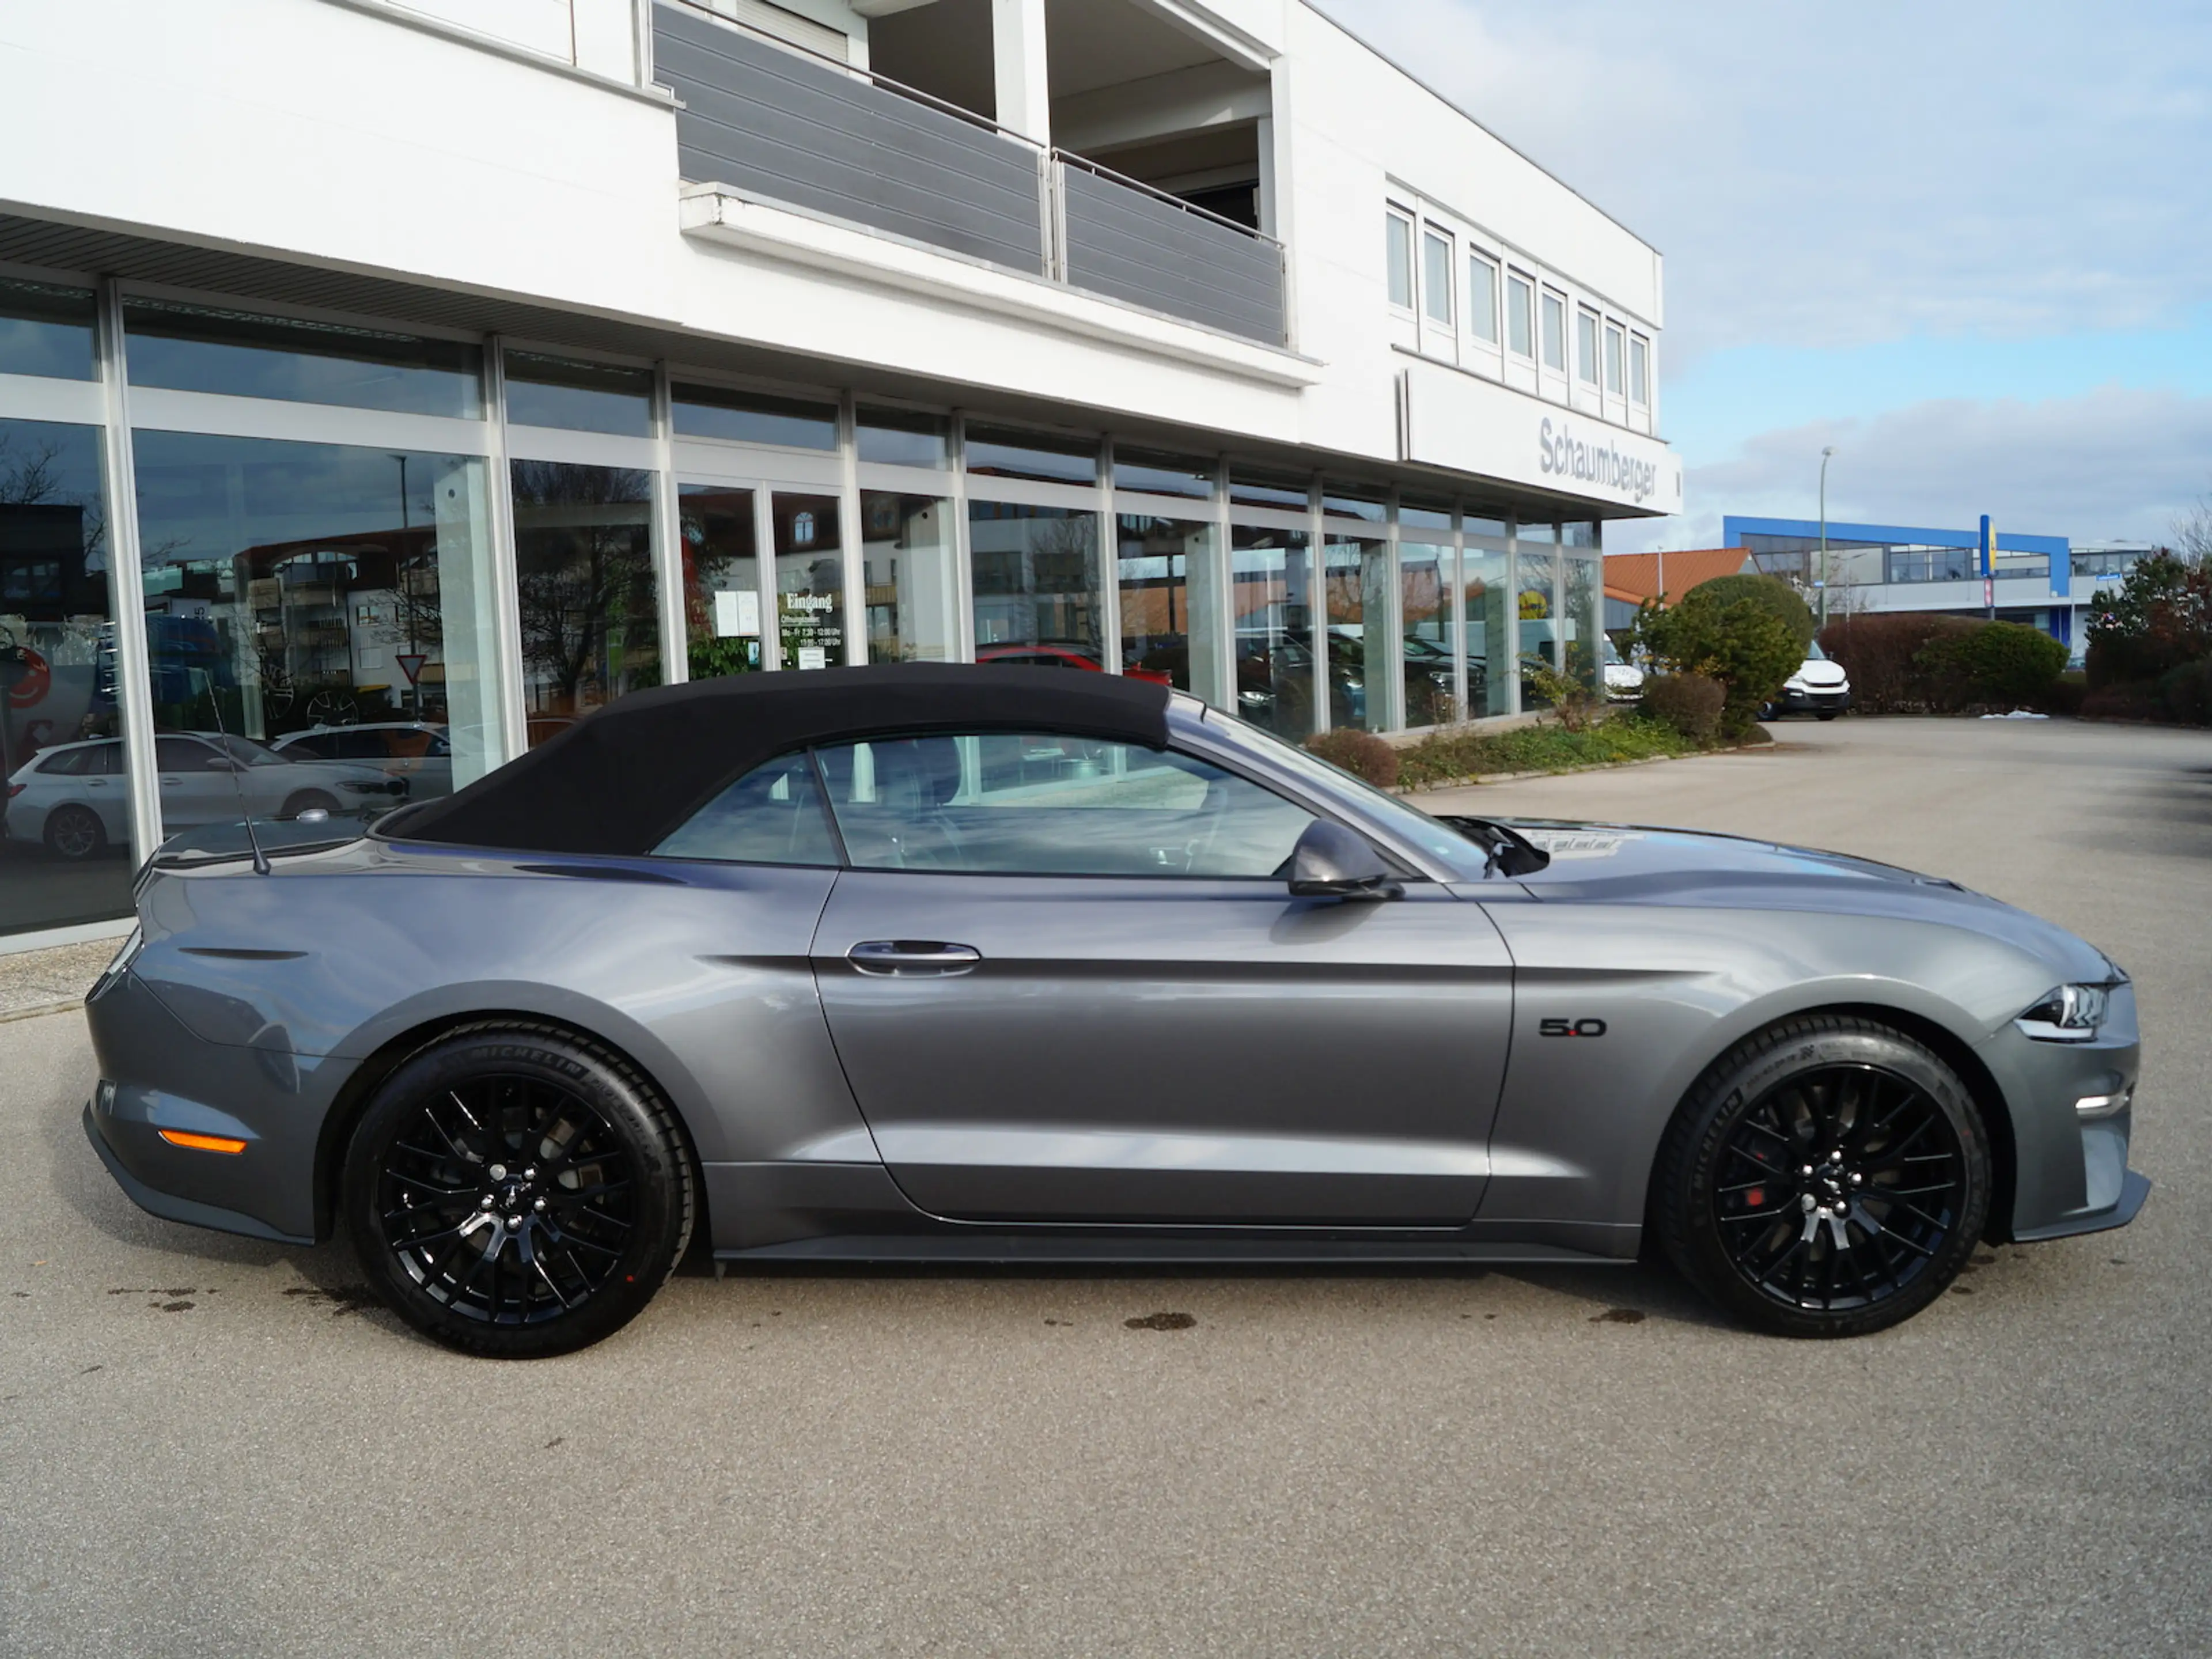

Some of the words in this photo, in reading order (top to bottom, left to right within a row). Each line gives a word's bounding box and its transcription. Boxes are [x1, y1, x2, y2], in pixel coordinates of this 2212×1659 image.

[1540, 417, 1656, 503] Schaumberger
[787, 593, 833, 613] Eingang
[1539, 1018, 1607, 1037] 5.0
[471, 1044, 582, 1076] MICHELIN
